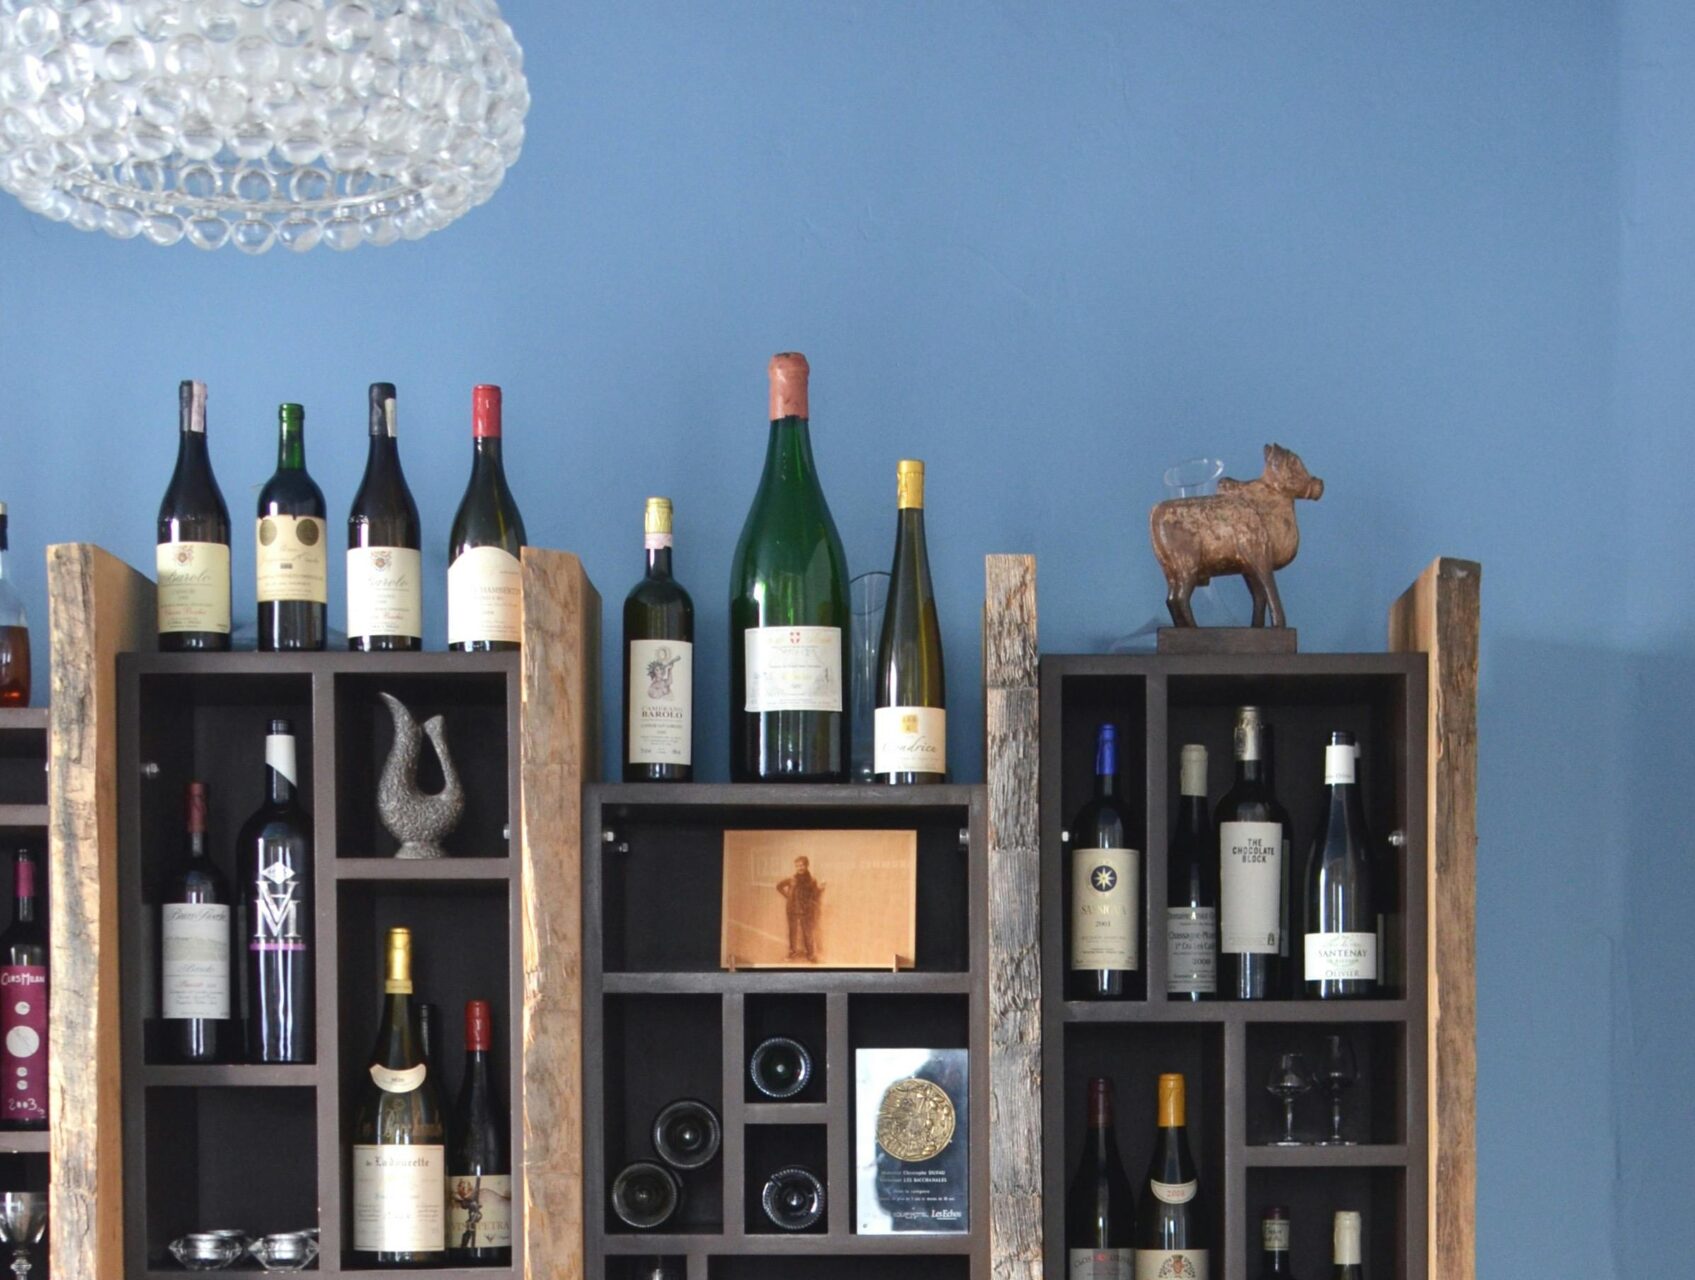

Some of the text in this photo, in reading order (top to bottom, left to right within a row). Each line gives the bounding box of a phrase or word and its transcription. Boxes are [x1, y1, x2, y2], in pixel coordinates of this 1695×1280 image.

[1248, 838, 1262, 847] THE
[1232, 846, 1275, 856] CHOCOLATE
[1242, 855, 1266, 863] BLOCK
[1318, 949, 1368, 958] SANTENAY
